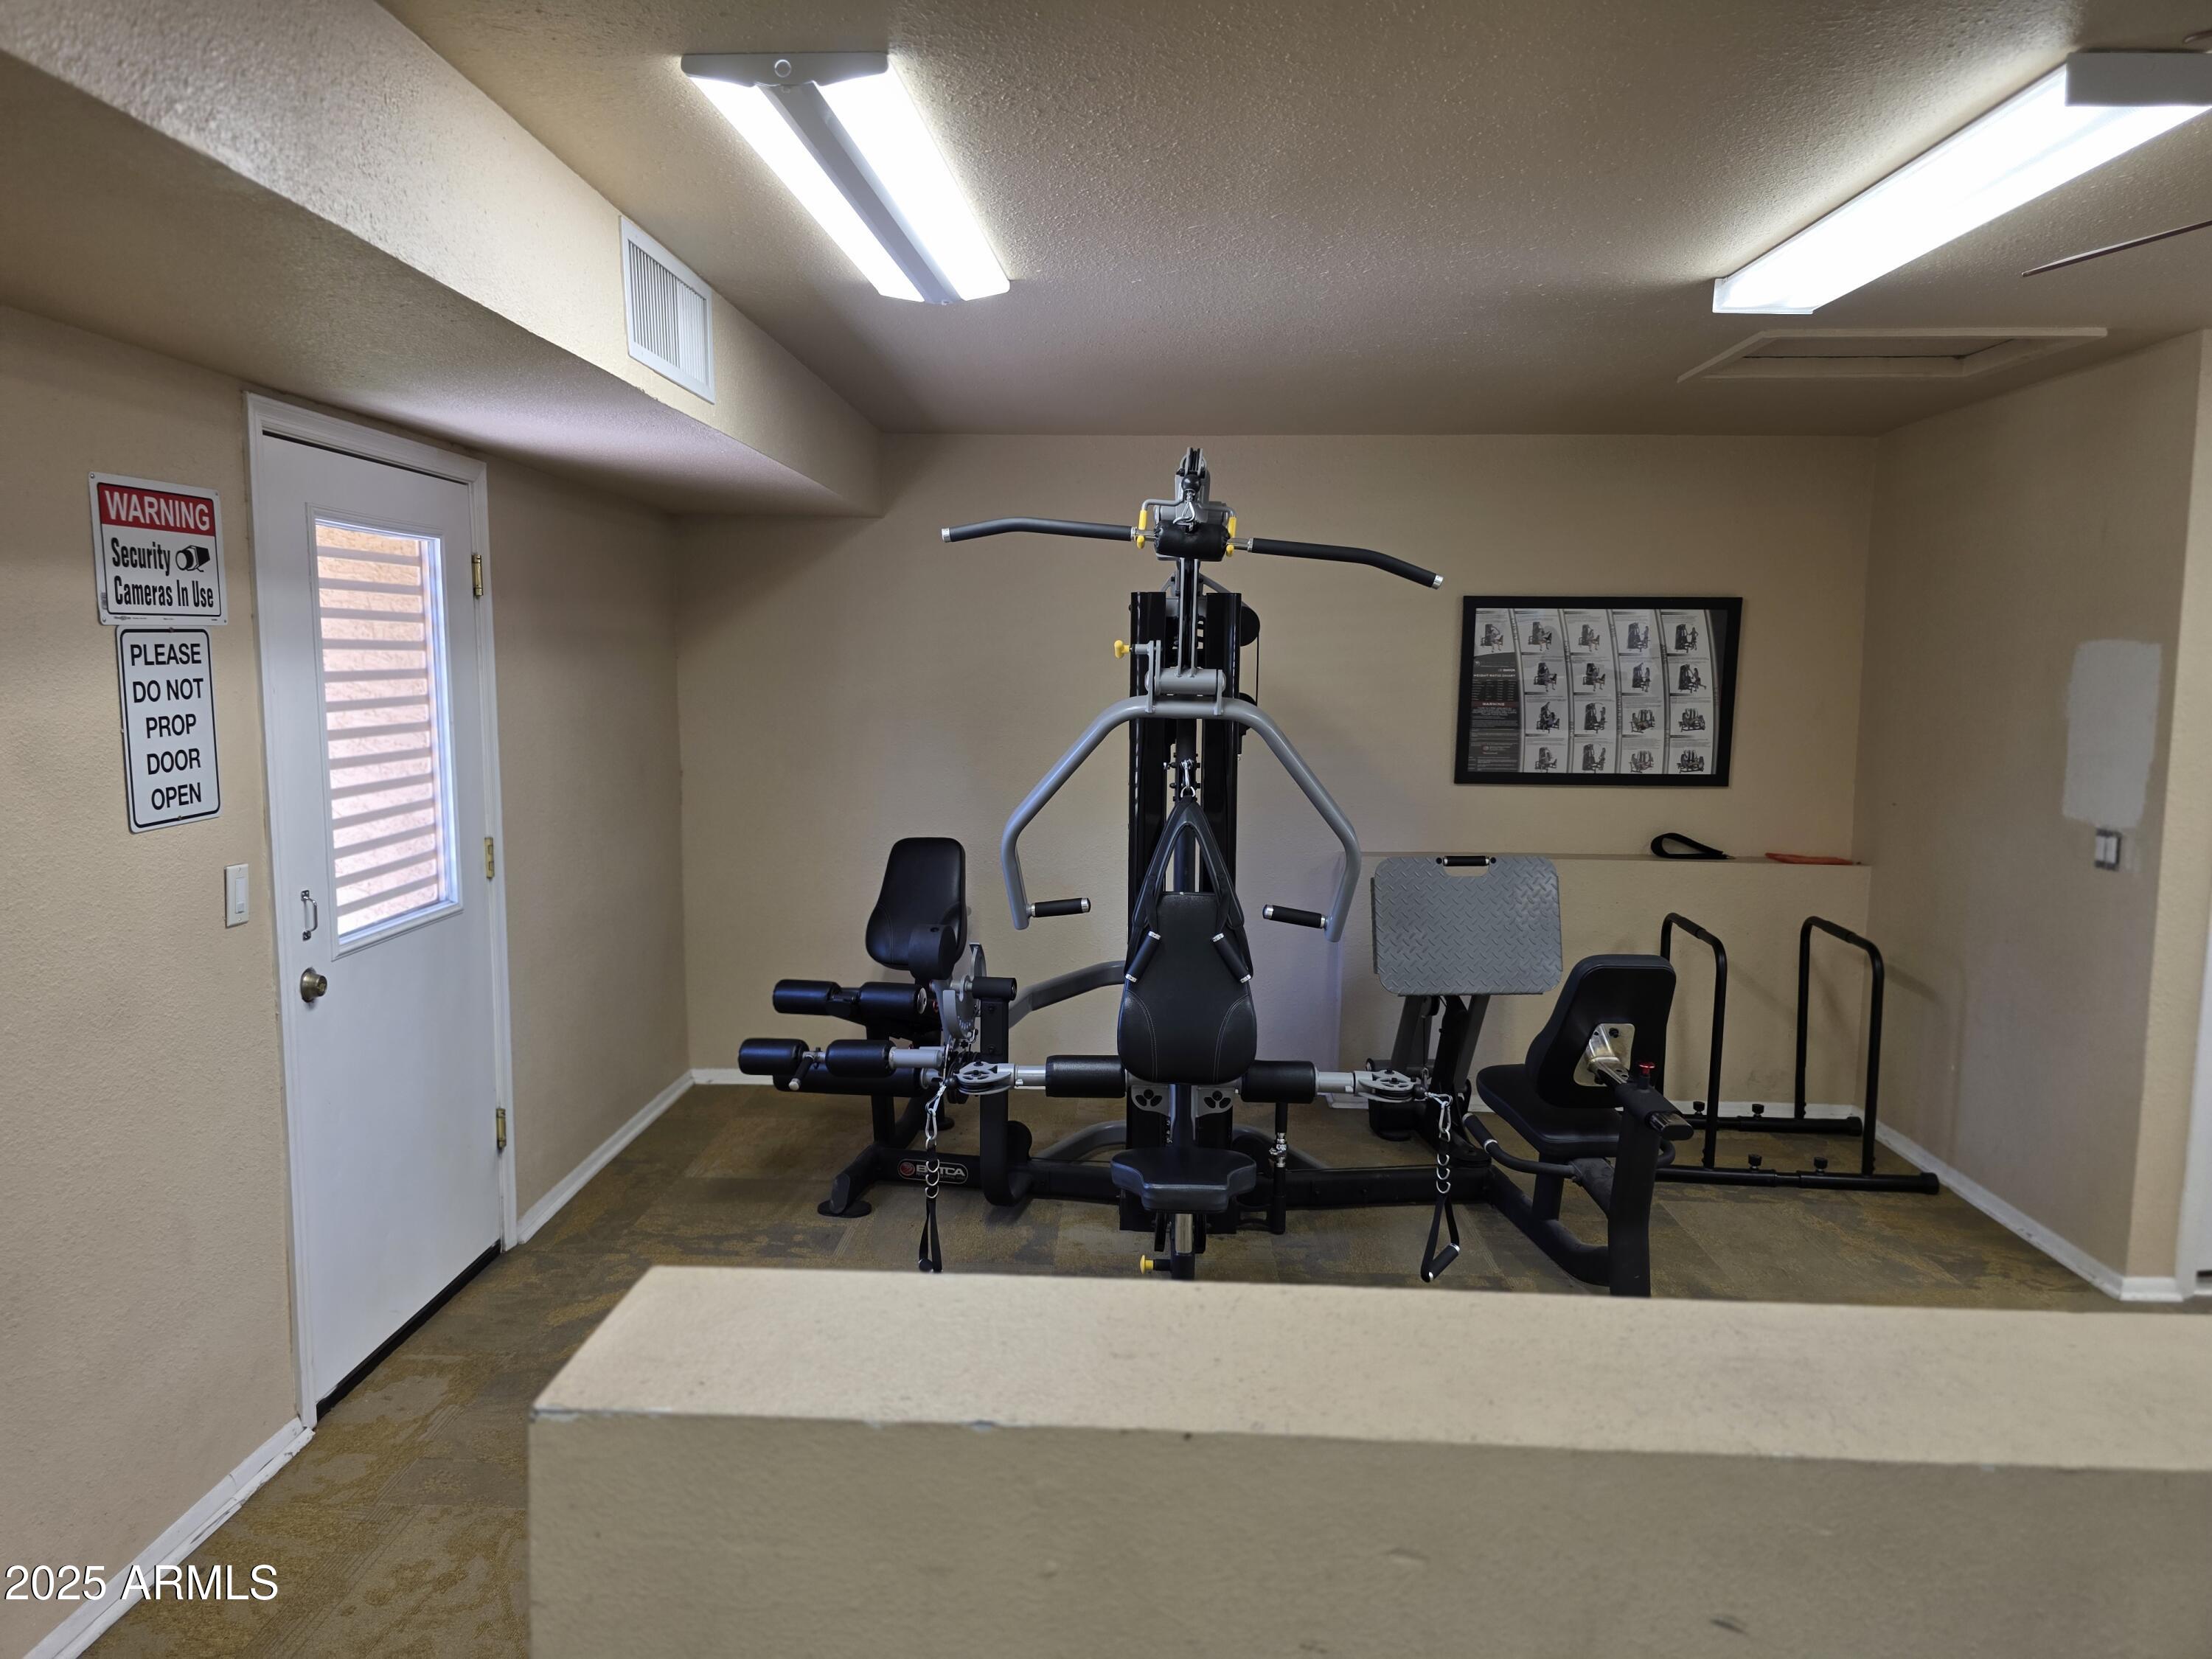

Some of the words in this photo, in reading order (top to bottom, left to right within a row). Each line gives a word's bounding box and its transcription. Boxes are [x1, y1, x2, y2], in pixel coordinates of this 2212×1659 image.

[105, 490, 210, 531] WARNING
[111, 537, 170, 577] Security
[114, 575, 173, 607] Cameras
[176, 580, 189, 606] In
[192, 580, 214, 608] Use
[130, 643, 202, 666] PLEASE
[133, 680, 161, 703] DO
[167, 678, 204, 700] NOT
[145, 713, 197, 738] PROP
[147, 748, 201, 775] DOOR
[151, 782, 202, 810] OPEN
[916, 1165, 965, 1176] BTCA
